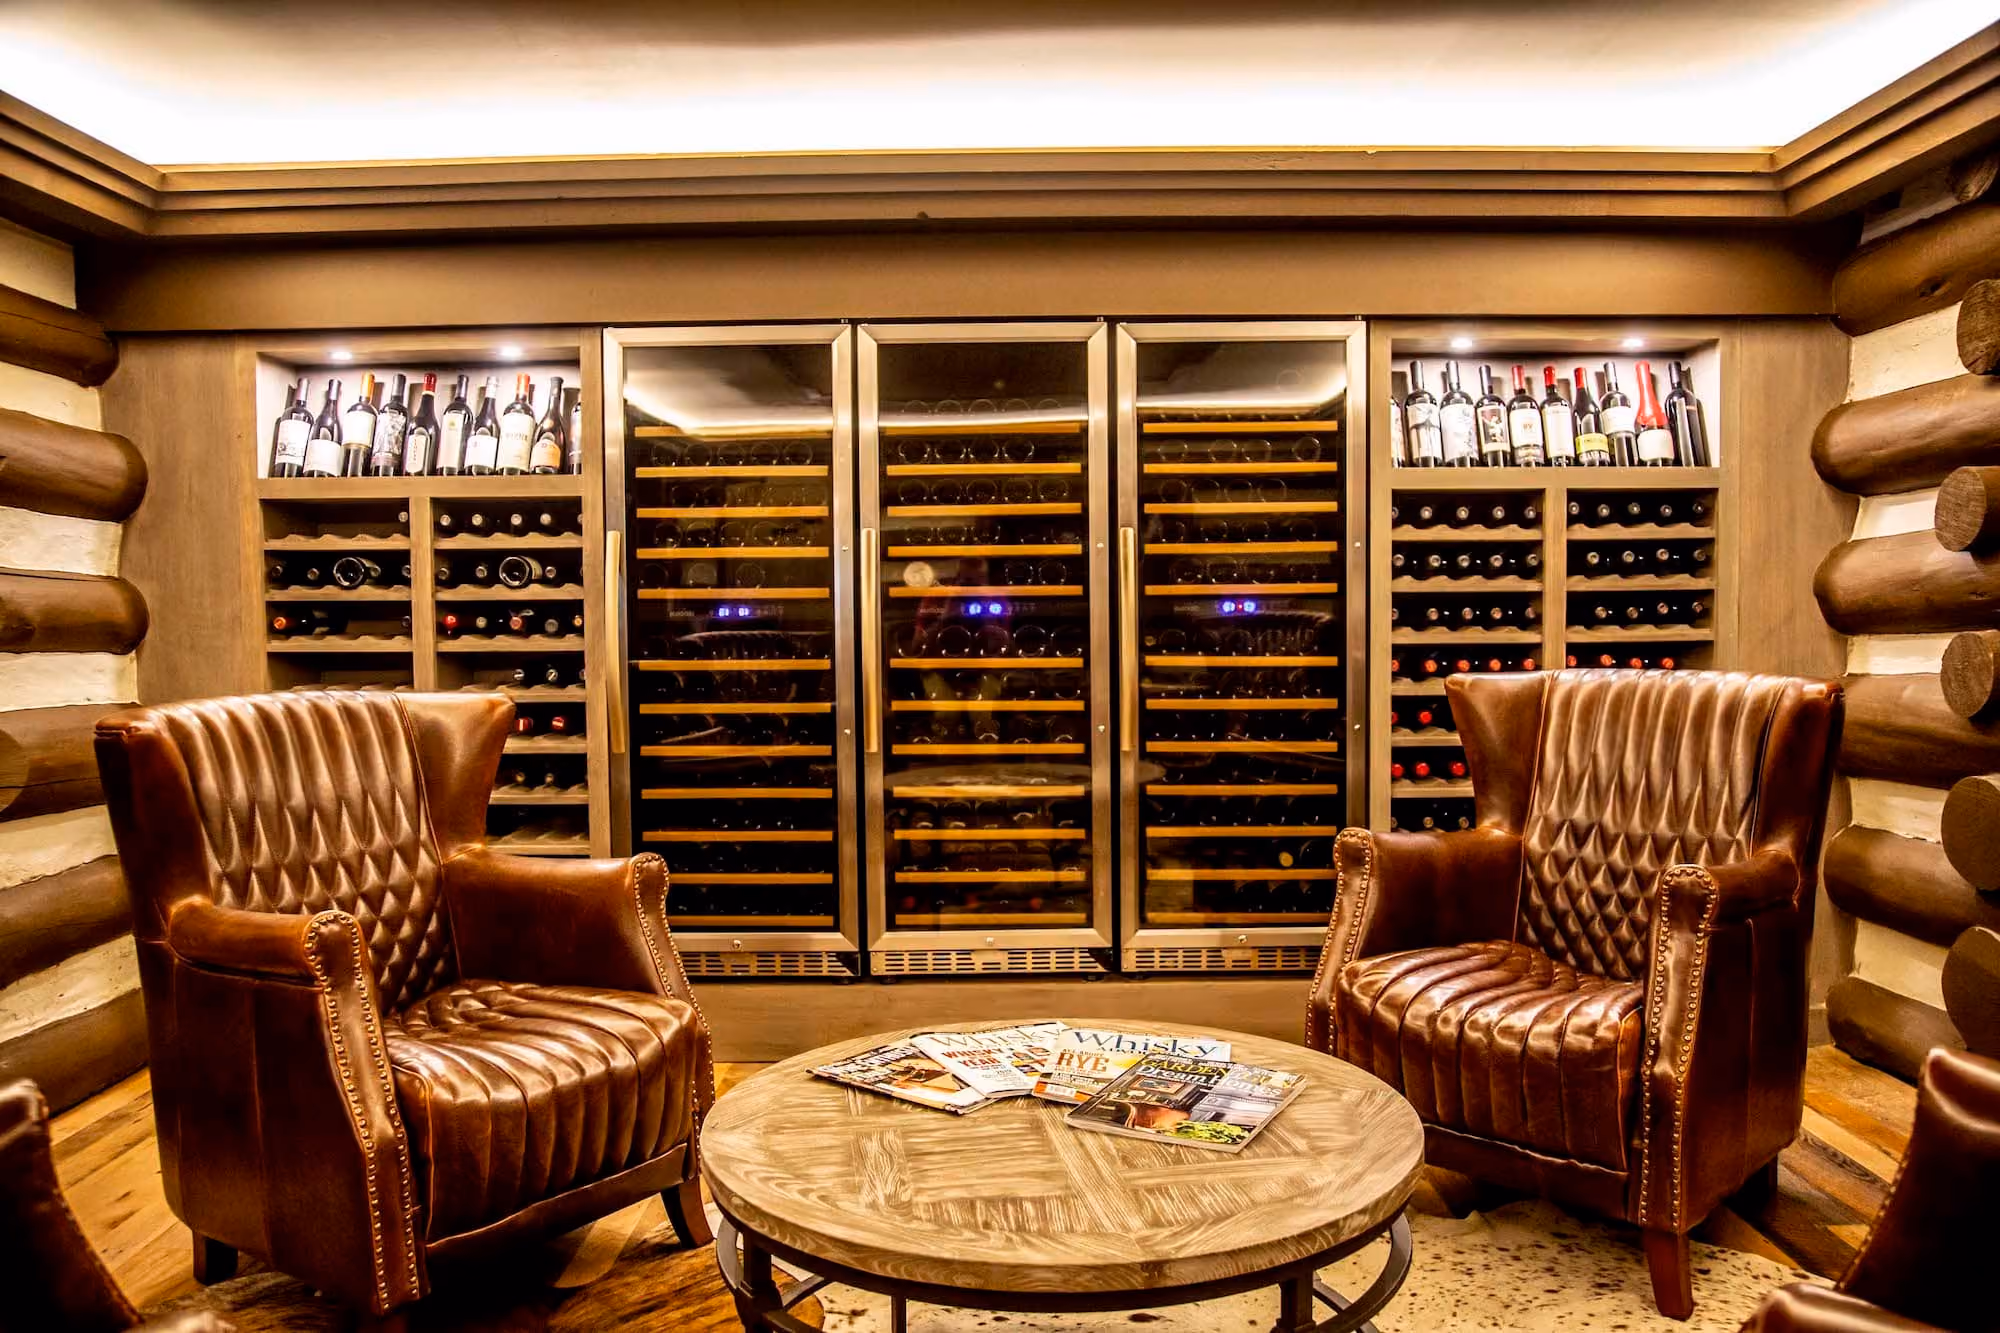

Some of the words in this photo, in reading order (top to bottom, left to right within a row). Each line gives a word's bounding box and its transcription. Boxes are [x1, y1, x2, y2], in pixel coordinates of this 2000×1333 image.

[928, 1028, 1061, 1048] Whisky
[1073, 1031, 1218, 1059] Whisky
[940, 1047, 1004, 1059] WHISKY
[957, 1056, 1001, 1068] YEAR
[1056, 1052, 1110, 1073] RYE
[1135, 1065, 1209, 1084] Dream
